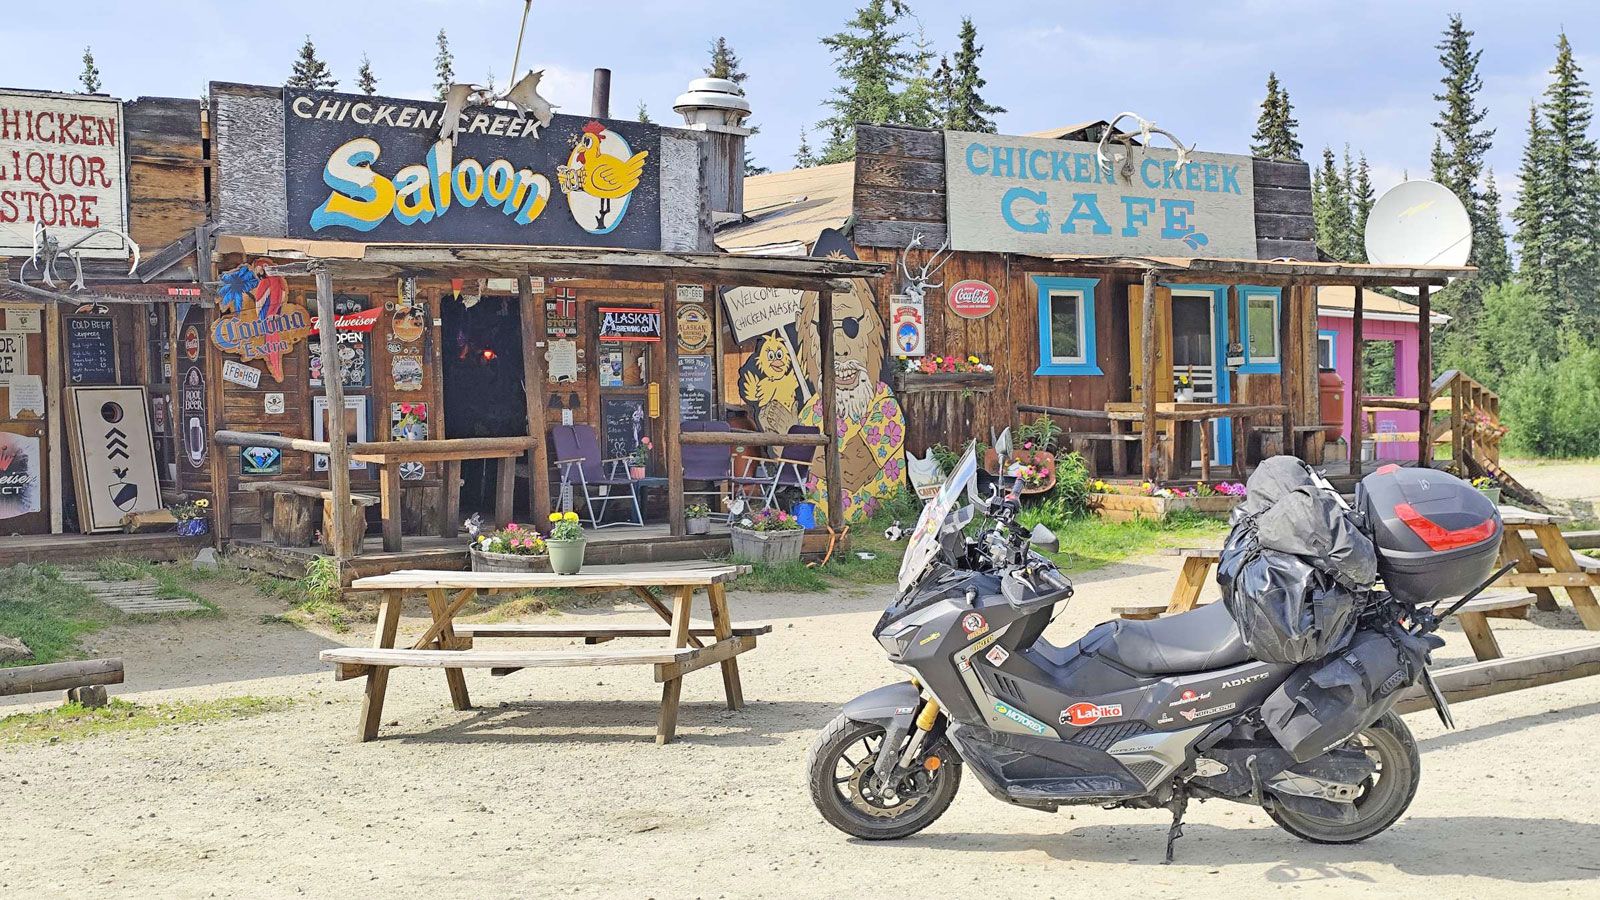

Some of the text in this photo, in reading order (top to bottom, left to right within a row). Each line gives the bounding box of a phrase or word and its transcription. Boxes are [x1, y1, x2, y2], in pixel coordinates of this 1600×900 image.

[292, 96, 440, 129] CHICKEN
[965, 142, 1243, 195] CHICKEN CREEK
[309, 137, 551, 232] Saloon
[0, 190, 99, 228] STORE
[1000, 187, 1196, 240] CAFE
[730, 286, 780, 311] WELCOME
[768, 299, 798, 317] ALASKA
[72, 320, 111, 329] COLD BEER
[215, 311, 305, 349] Corona
[547, 319, 576, 327] STOUT
[600, 313, 660, 336] ALASKAN
[244, 340, 288, 358] Extra
[185, 400, 203, 410] BEER
[1006, 709, 1045, 733] MOTOREX
[1077, 706, 1120, 719] Labiko
